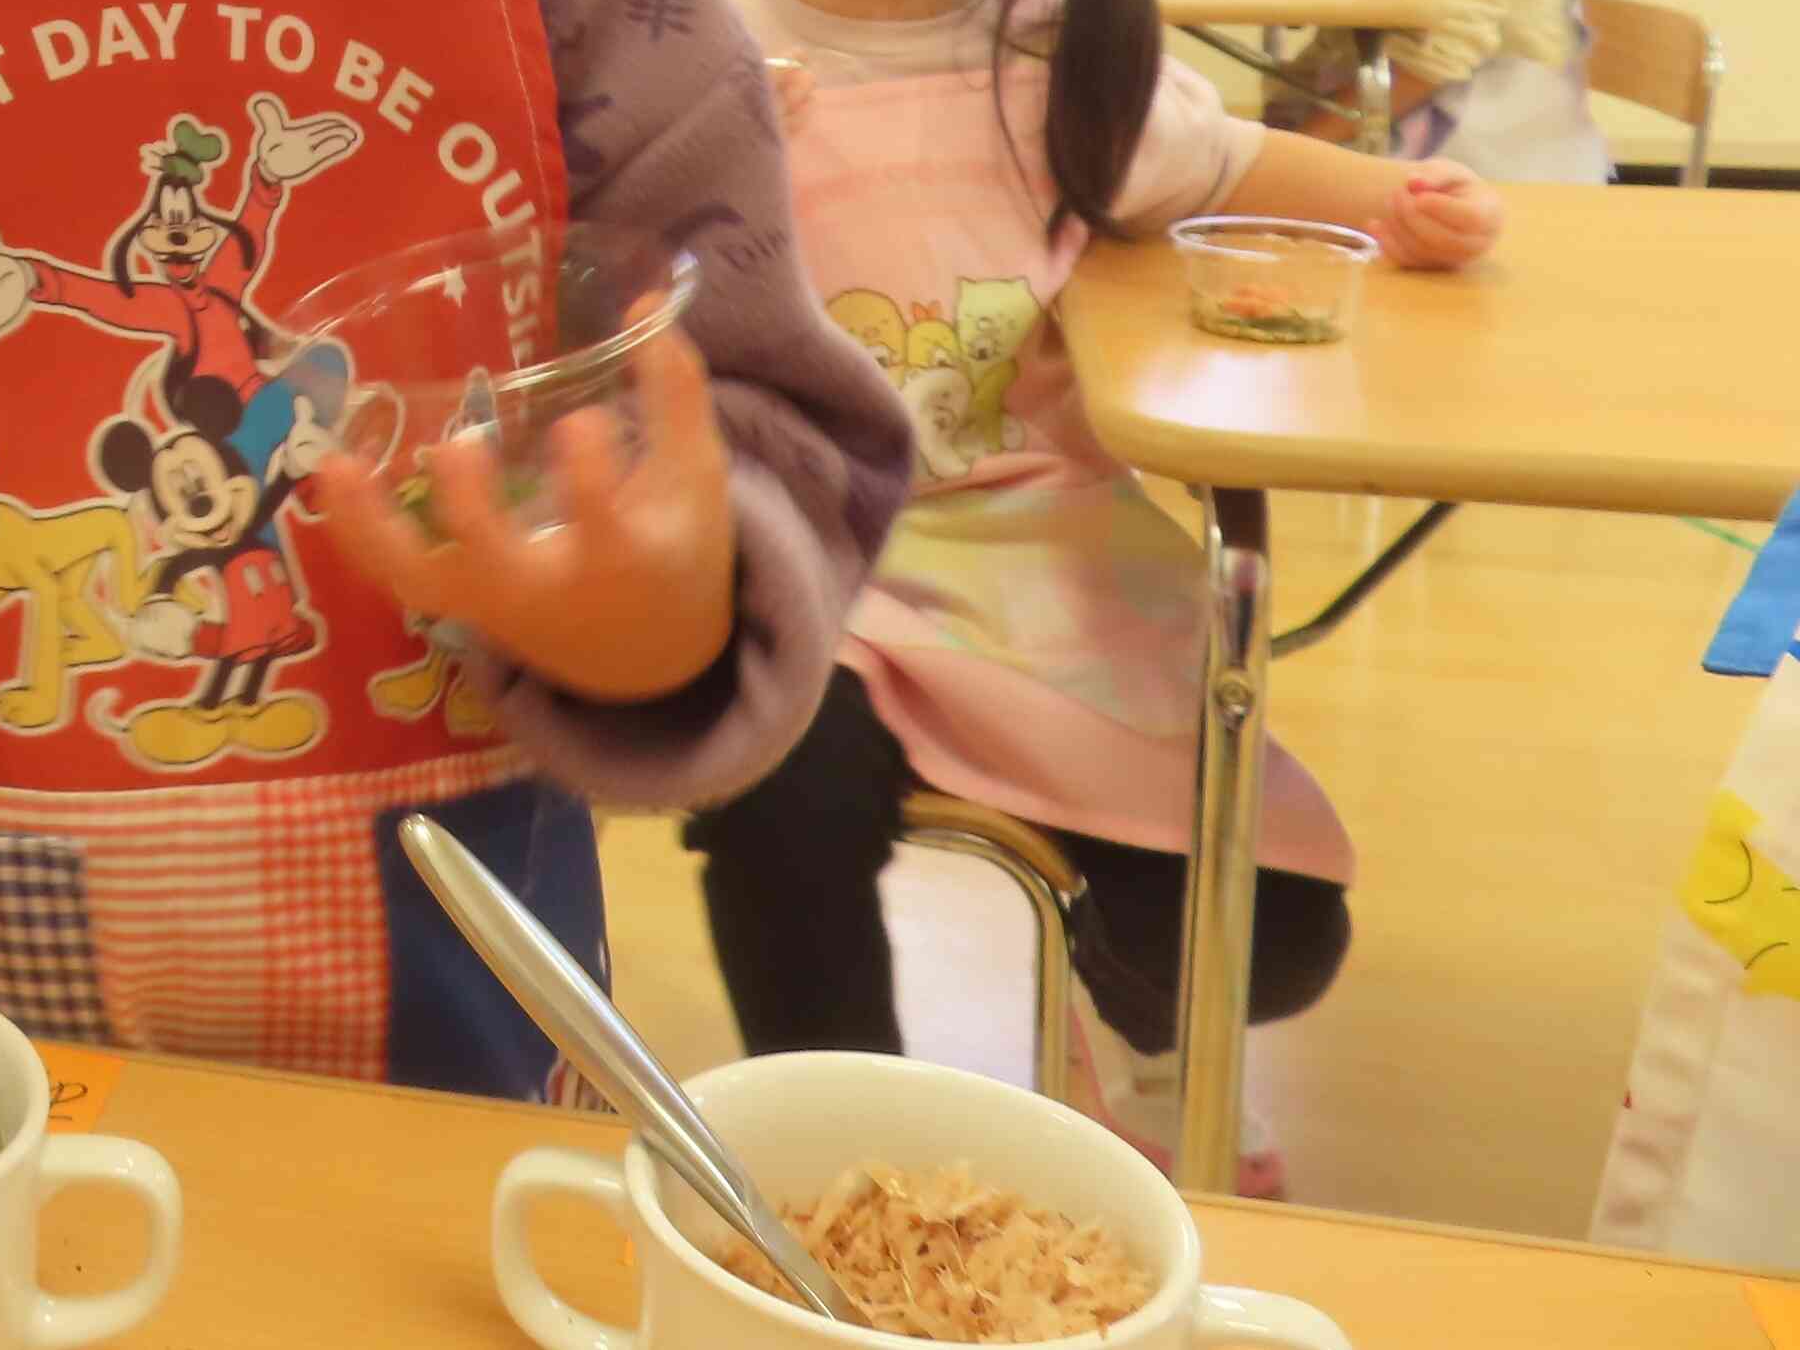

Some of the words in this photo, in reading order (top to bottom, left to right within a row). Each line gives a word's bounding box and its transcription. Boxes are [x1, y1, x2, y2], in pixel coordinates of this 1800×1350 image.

[31, 2, 188, 82] DAY
[216, 3, 316, 74] TO
[333, 39, 435, 134] BE
